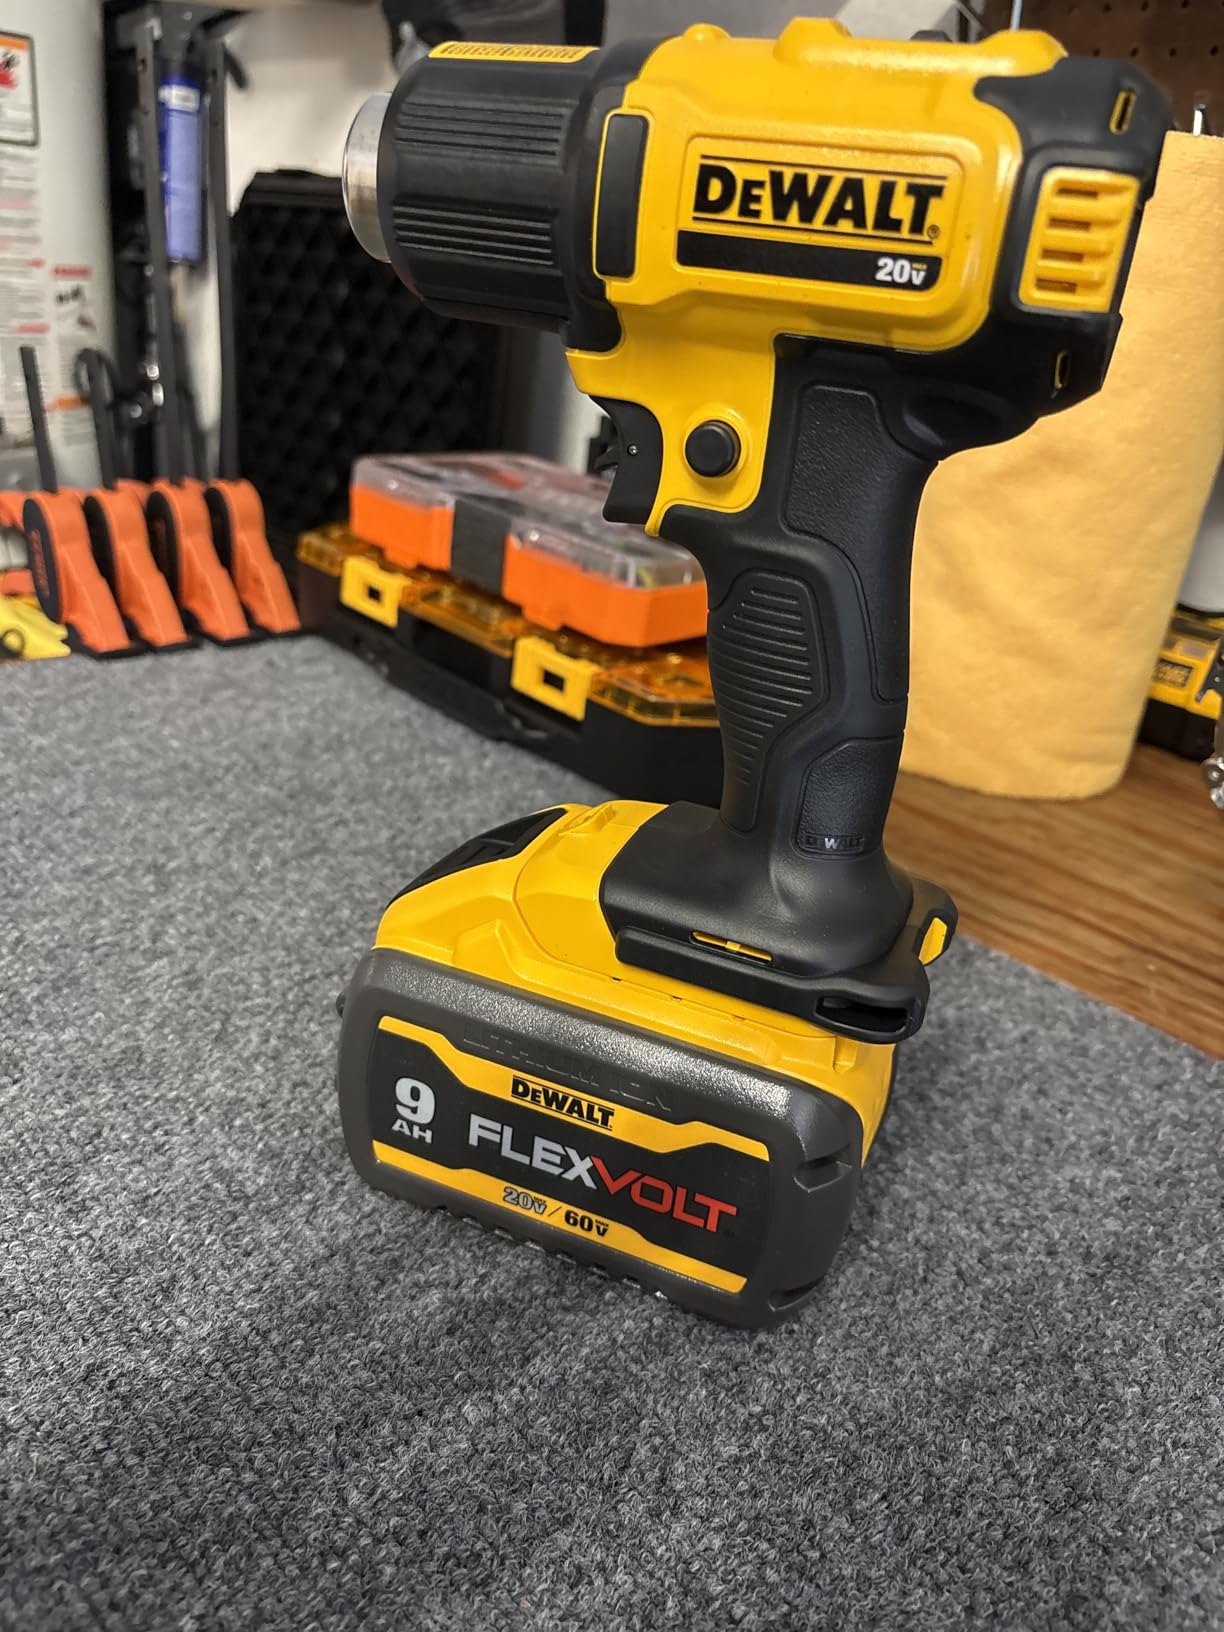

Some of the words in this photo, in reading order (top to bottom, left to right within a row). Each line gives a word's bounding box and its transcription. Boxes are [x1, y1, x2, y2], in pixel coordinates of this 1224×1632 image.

[395, 1077, 436, 1124] 9
[512, 1078, 614, 1128] DEWALT
[391, 1118, 433, 1144] AH
[468, 1113, 738, 1233] FLEXVOLT
